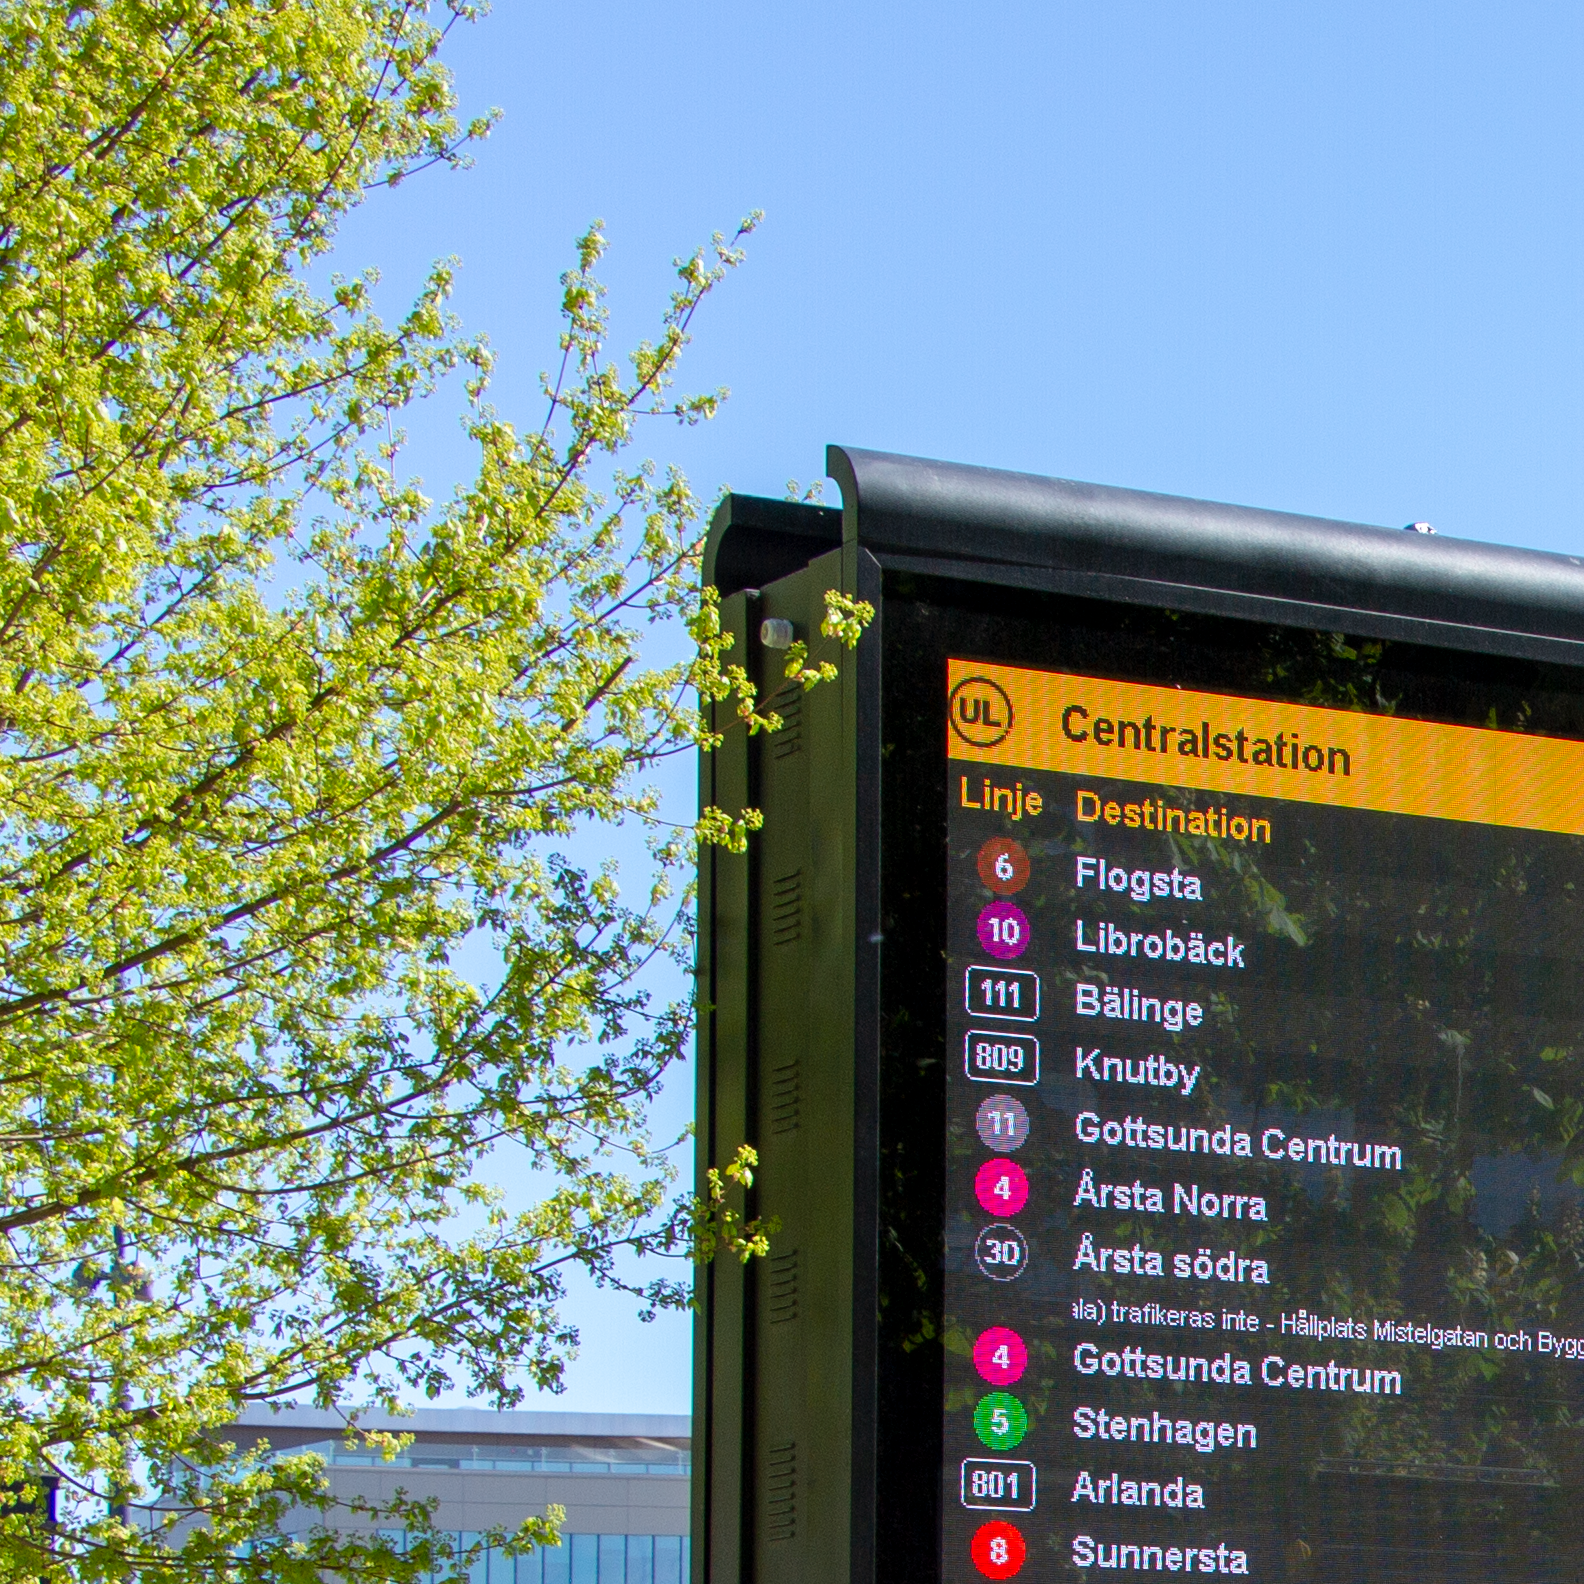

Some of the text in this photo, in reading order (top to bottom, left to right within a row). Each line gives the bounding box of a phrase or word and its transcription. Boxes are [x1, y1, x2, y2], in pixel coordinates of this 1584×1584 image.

[959, 697, 1001, 728] UL
[1061, 704, 1352, 776] Centralstation
[960, 776, 1043, 821] Linje
[1076, 790, 1272, 843] Destination
[995, 854, 1013, 881] 6
[1076, 856, 1203, 902] Flogsta
[989, 916, 1021, 944] 10
[1076, 919, 1246, 968] Librobäck
[981, 978, 1021, 1008] 111
[1075, 983, 1204, 1031] Bälinge
[975, 1043, 1024, 1072] 809
[1075, 1047, 1200, 1095] Knutby
[988, 1110, 1016, 1136] 11
[1074, 1111, 1252, 1158] Gottsunda
[1262, 1127, 1402, 1170] Centrum
[994, 1175, 1012, 1200] 4
[1073, 1168, 1164, 1212] Årsta
[1174, 1183, 1268, 1222] Norra
[984, 1237, 1020, 1265] 30
[1072, 1232, 1164, 1277] Årsta
[1173, 1248, 1270, 1284] södra
[1111, 1301, 1216, 1329] trafikeras
[1221, 1308, 1260, 1332] inte
[1281, 1309, 1368, 1342] Hållplats
[1374, 1319, 1487, 1350] Mistelgatan
[1494, 1329, 1532, 1352] och
[992, 1344, 1010, 1368] 4
[1073, 1343, 1253, 1385] Gottsunda
[1260, 1356, 1402, 1394] Centrum
[991, 1409, 1009, 1435] 5
[1072, 1407, 1257, 1453] Stenhagen
[972, 1470, 1019, 1499] 801
[1071, 1471, 1206, 1508] Arlanda
[989, 1537, 1008, 1564] 8
[1072, 1535, 1249, 1574] Sunnersta
